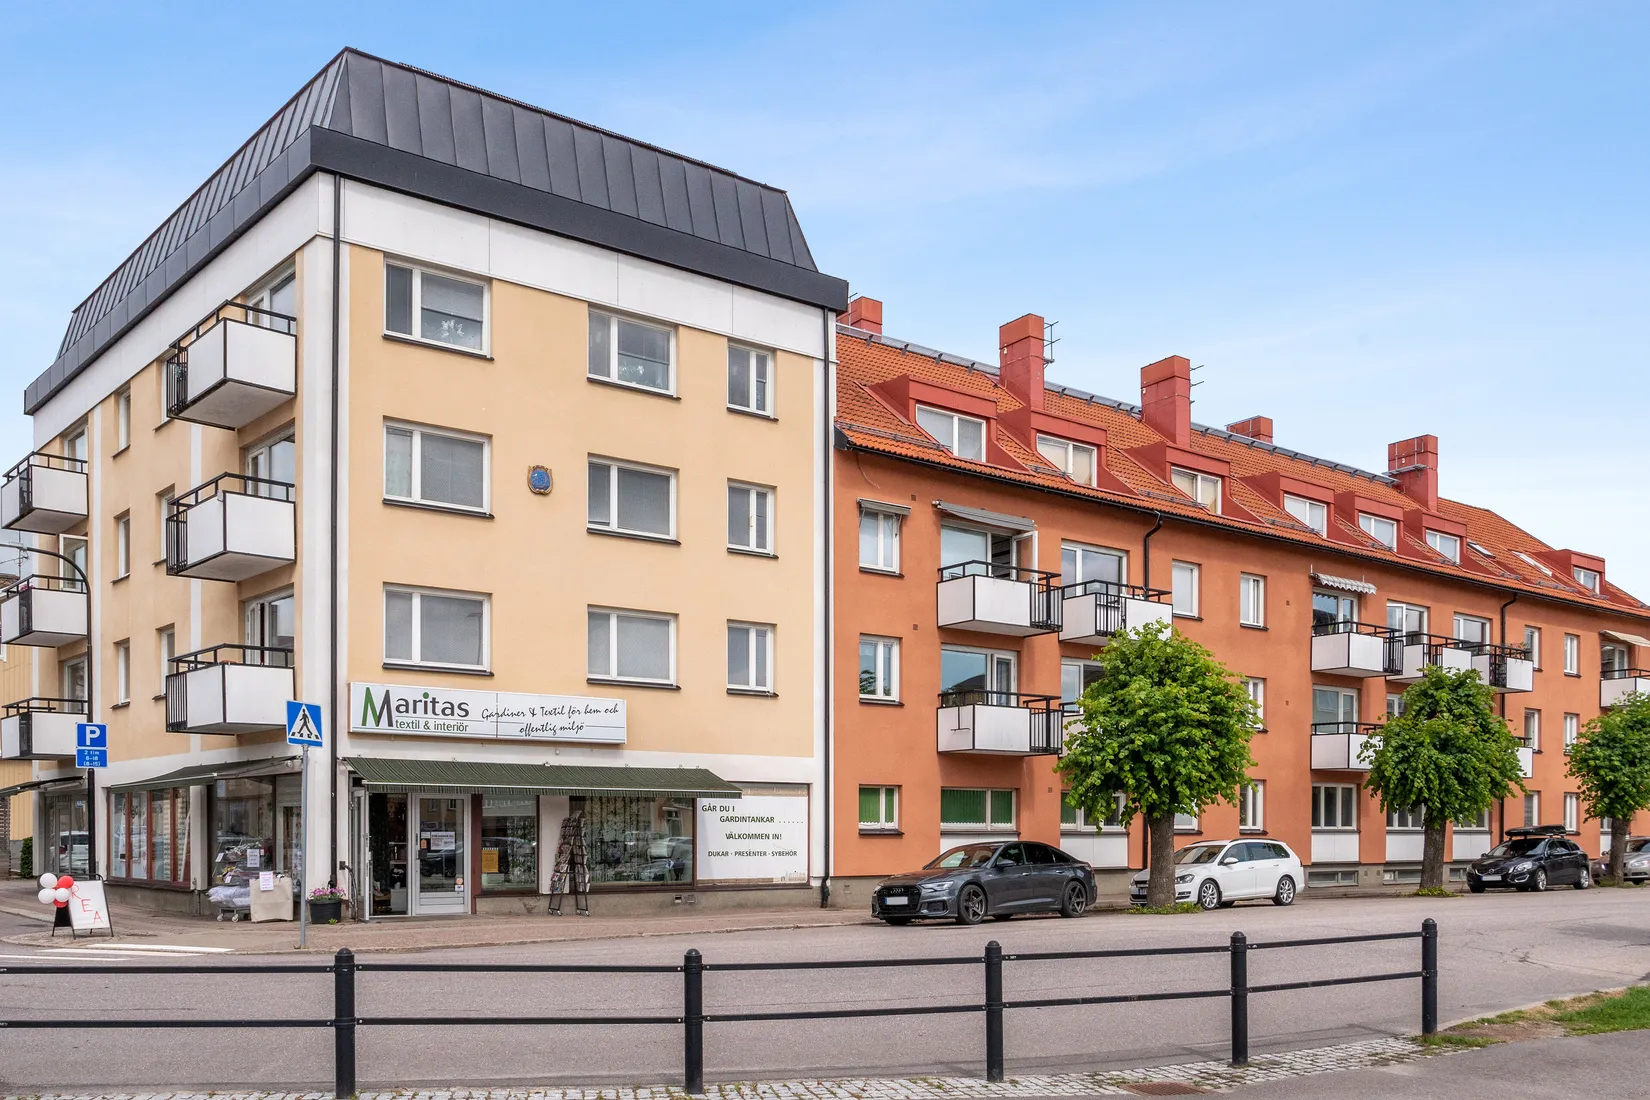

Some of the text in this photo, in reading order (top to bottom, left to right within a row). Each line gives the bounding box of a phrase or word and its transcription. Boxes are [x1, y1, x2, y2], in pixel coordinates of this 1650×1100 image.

[361, 686, 470, 728] Maritas
[481, 702, 620, 720] Gardiner & Textil för hem och
[395, 719, 469, 733] textil & interiör
[519, 721, 585, 737] offentlig miljö
[85, 725, 101, 746] P
[702, 803, 717, 812] GÅR
[719, 815, 775, 823] GARDINTANKAR
[725, 831, 770, 840] VÄLKOMMEN
[771, 849, 798, 857] SYBEHÖR
[71, 884, 104, 924] REA
